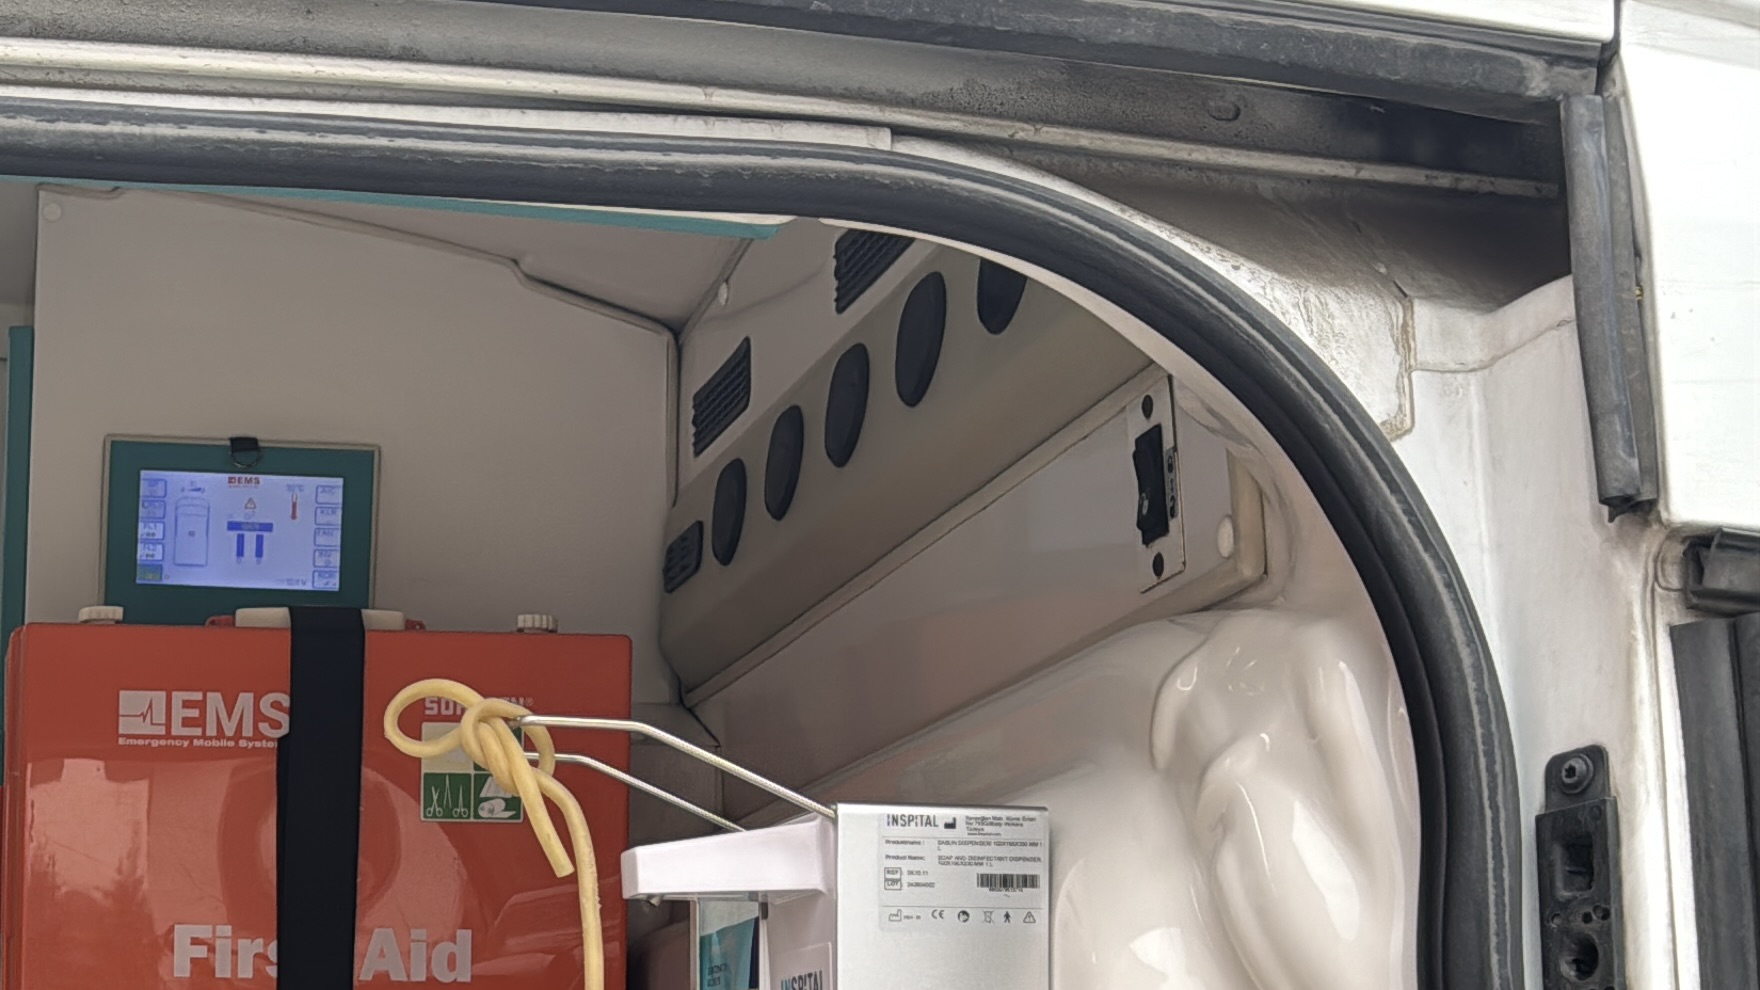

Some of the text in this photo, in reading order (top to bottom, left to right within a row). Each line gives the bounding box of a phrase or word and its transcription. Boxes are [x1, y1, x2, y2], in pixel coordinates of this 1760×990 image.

[237, 476, 260, 485] EMS
[171, 691, 291, 739] EMS
[118, 736, 278, 749] Emergency Mobile Syste
[173, 924, 472, 983] Fir Aid
